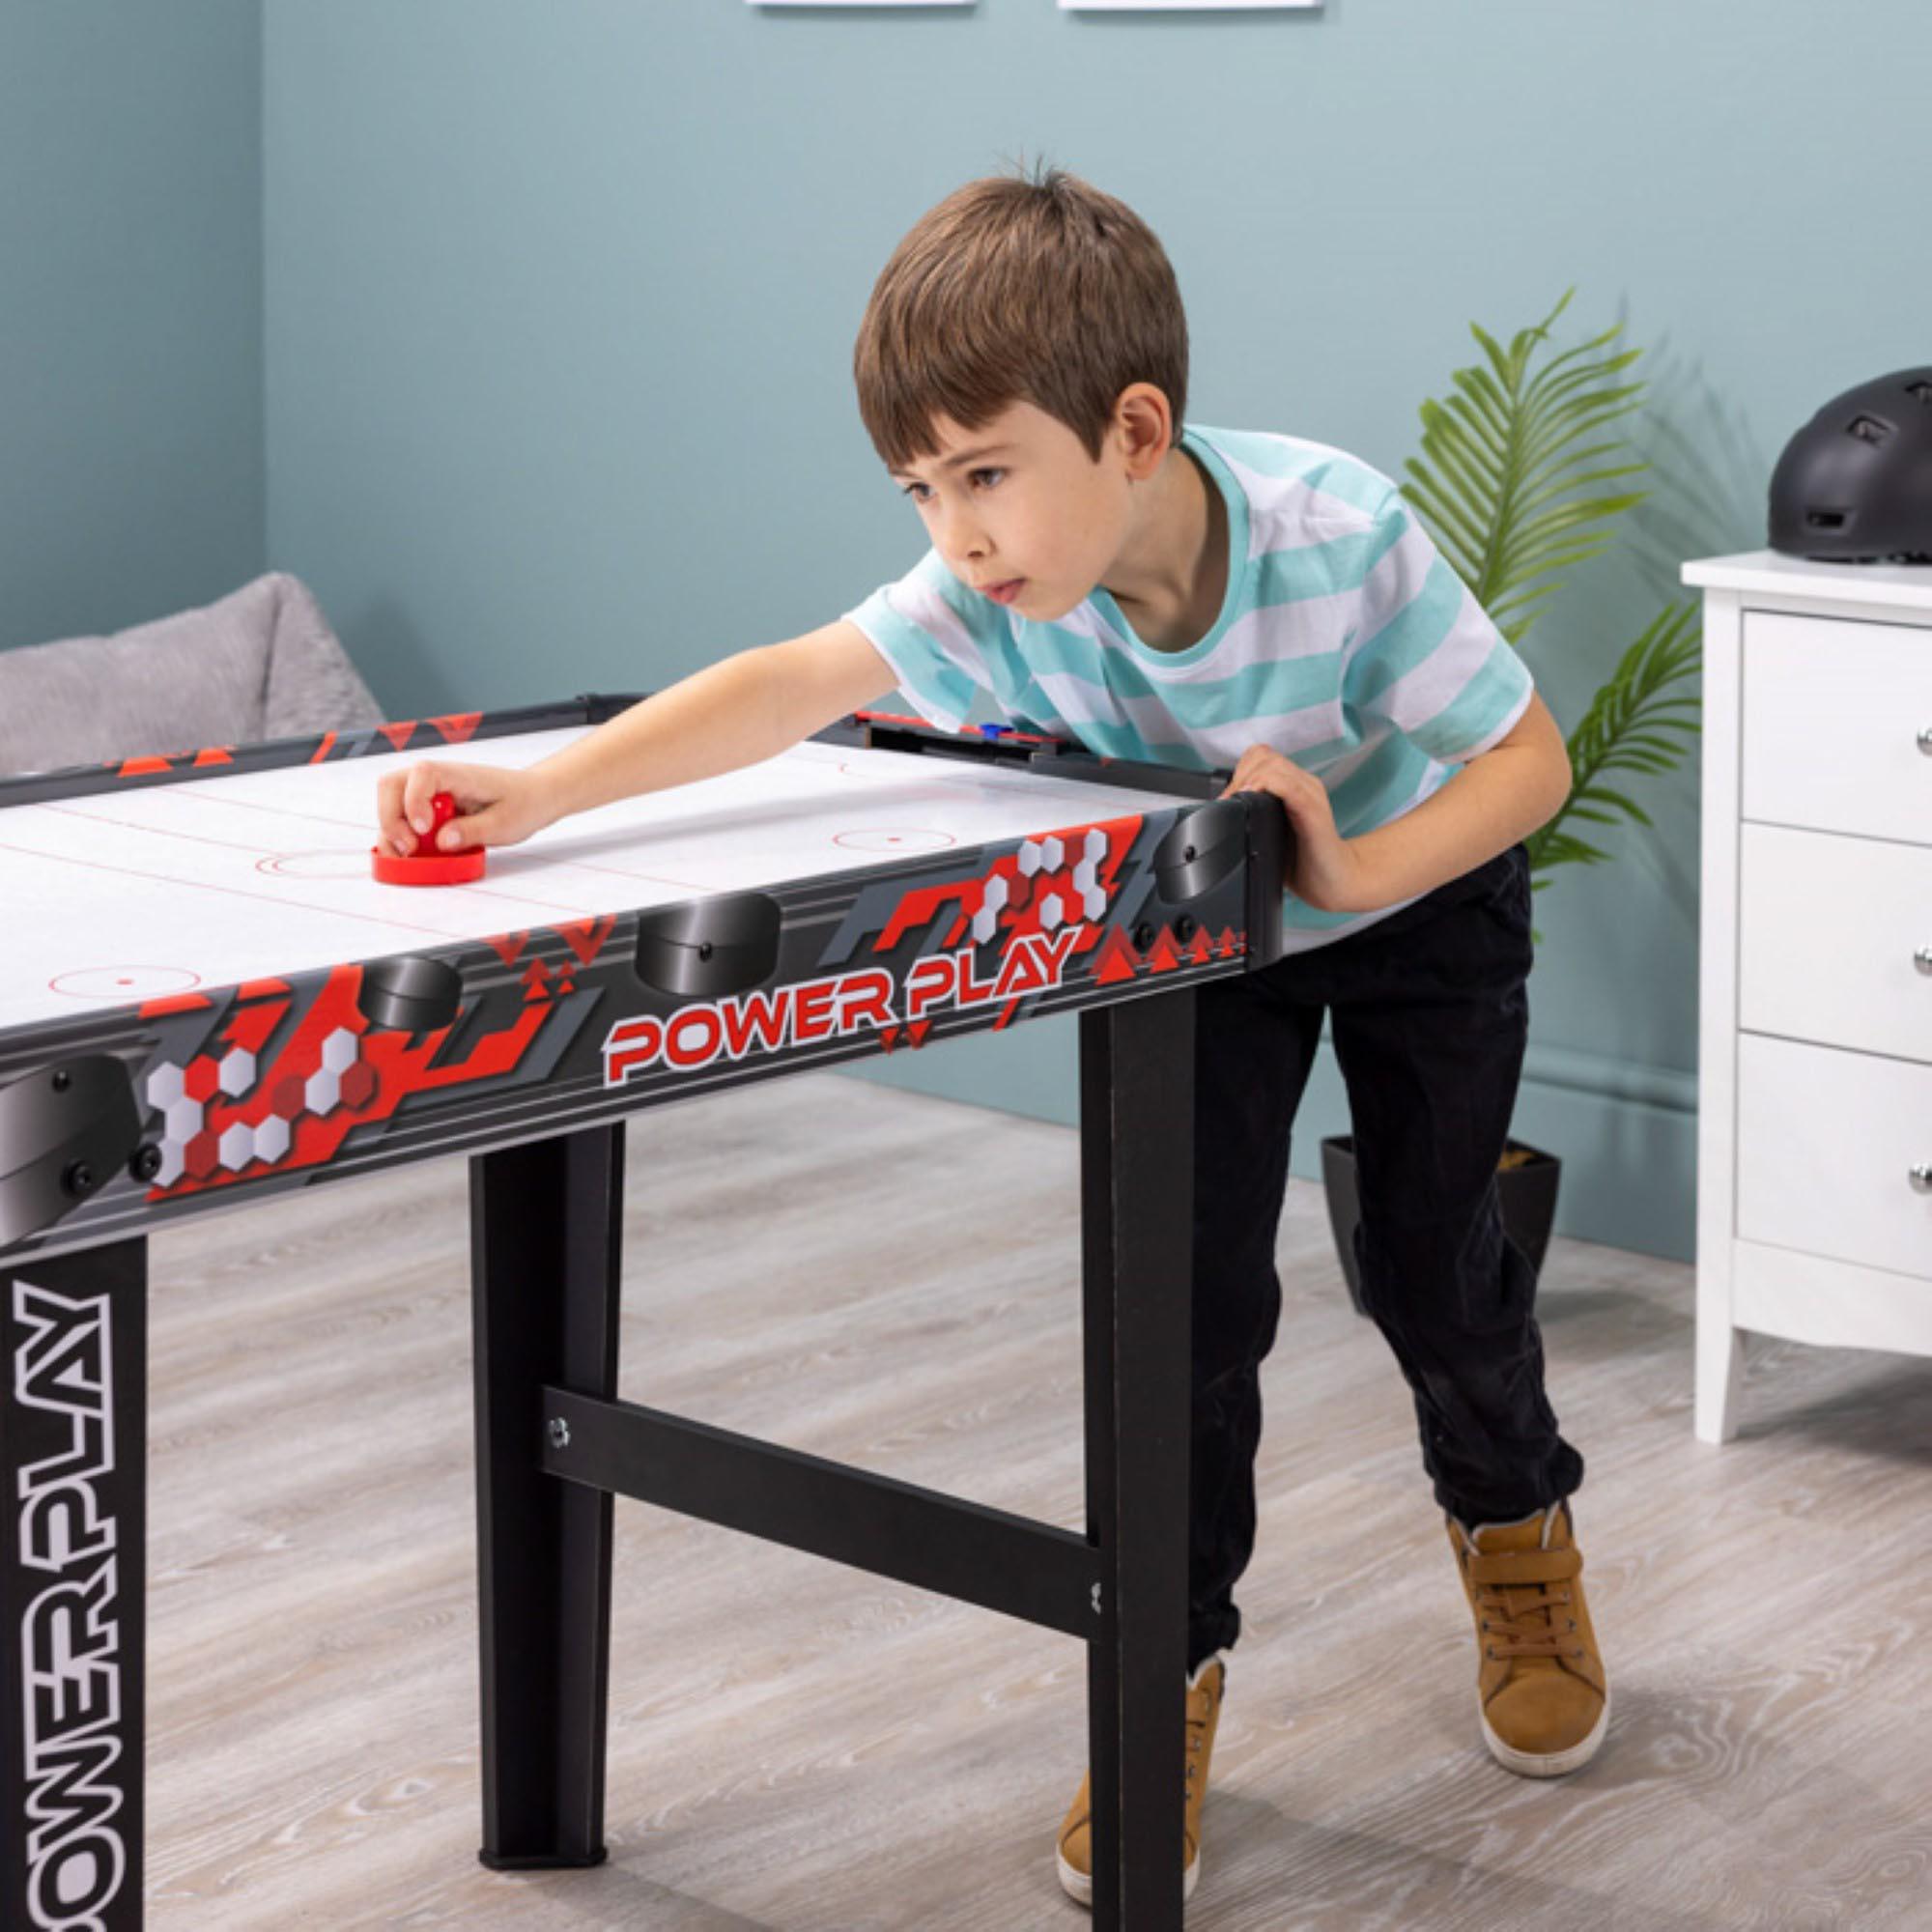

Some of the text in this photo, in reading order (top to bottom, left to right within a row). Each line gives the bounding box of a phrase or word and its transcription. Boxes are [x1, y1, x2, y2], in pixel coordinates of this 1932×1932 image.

[601, 924, 1084, 1089] POWER PLAY
[13, 1279, 126, 1932] OWER PLAY
